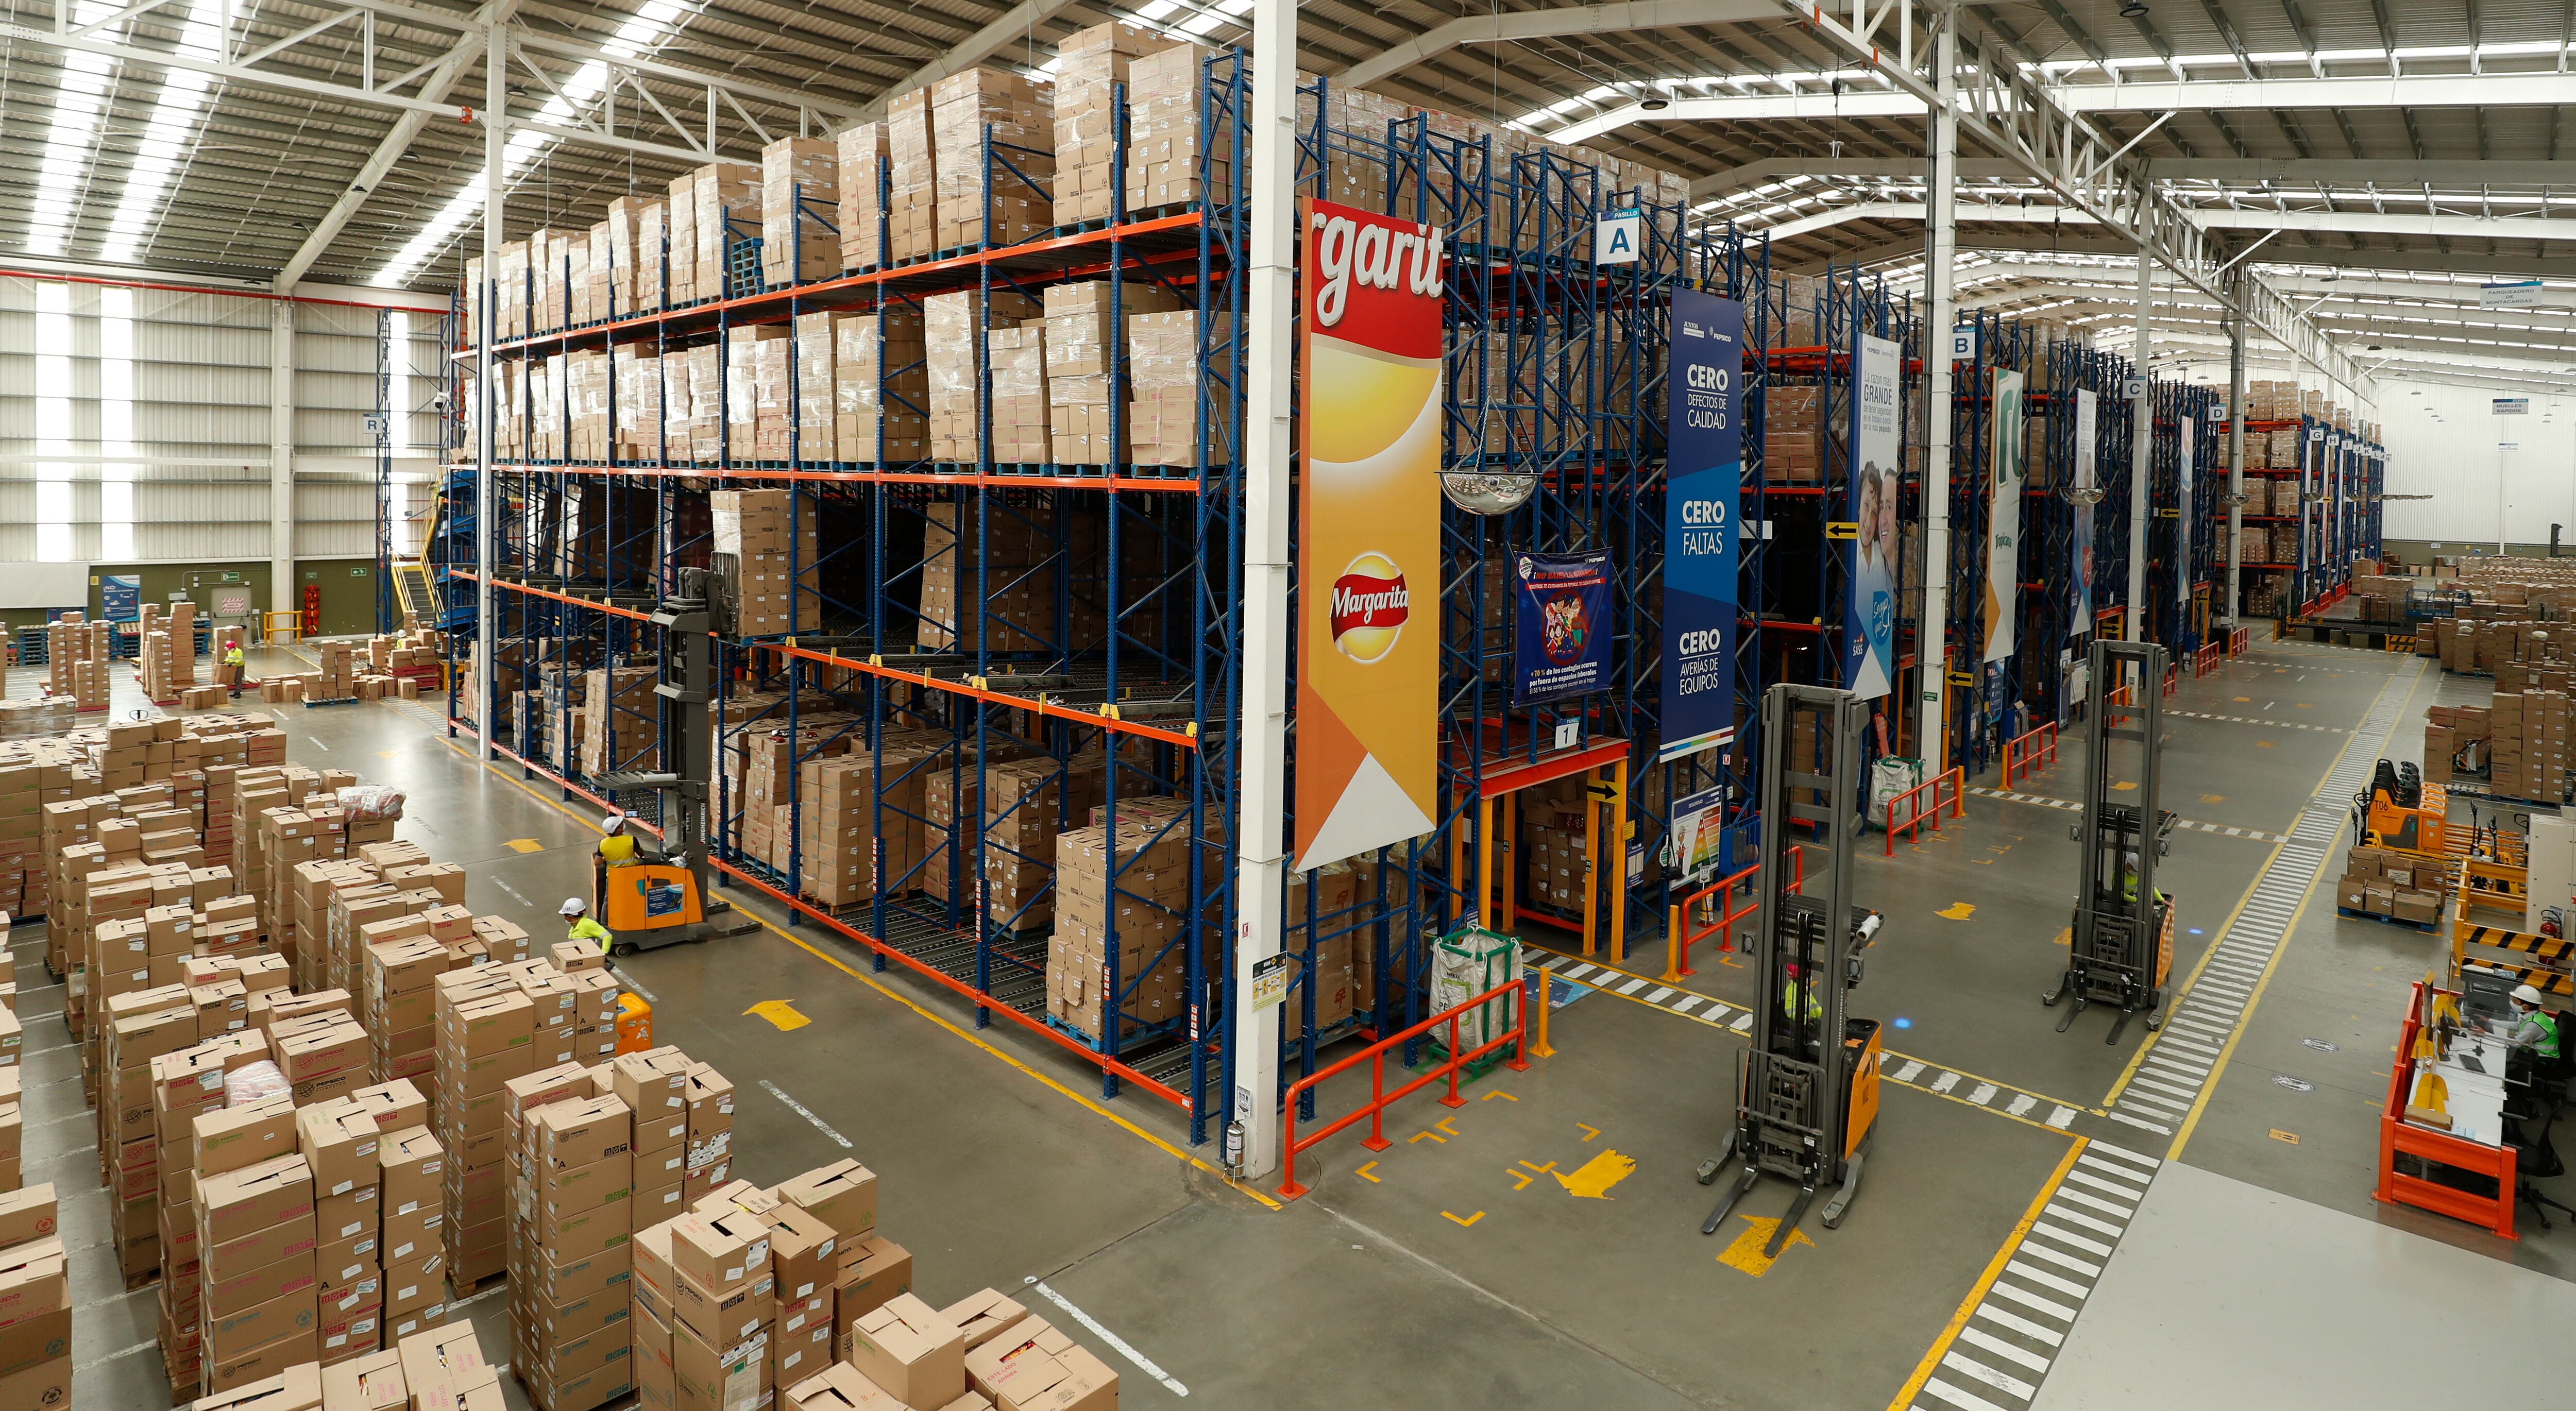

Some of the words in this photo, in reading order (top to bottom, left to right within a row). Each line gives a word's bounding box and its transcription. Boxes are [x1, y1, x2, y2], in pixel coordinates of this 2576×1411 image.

[1609, 228, 1631, 254] A
[1684, 321, 1699, 329] JUNTOS
[1714, 333, 1732, 342] PEPSICO
[1955, 338, 1969, 353] B
[1687, 364, 1728, 391] CERO
[1865, 370, 1870, 382] La
[1871, 372, 1882, 385] razón
[1883, 375, 1892, 386] más
[1864, 384, 1892, 405] GRANDE
[2129, 383, 2141, 395] C
[1688, 394, 1718, 409] DEFECTOS
[1719, 398, 1726, 410] DE
[1687, 410, 1726, 430] CALIDAD
[2214, 409, 2223, 418] D
[368, 420, 377, 430] R
[1683, 501, 1725, 523] CERO
[1684, 532, 1722, 555] FALTAS
[1995, 533, 2012, 549] Tropicana
[1329, 585, 1409, 624] Margarita
[1680, 628, 1720, 655] CERO
[1853, 644, 1863, 656] SASS
[1561, 664, 1581, 672] contagios
[1680, 657, 1708, 677] AVERÍAS
[1710, 657, 1718, 671] DE
[1558, 673, 1577, 683] espacios
[1577, 669, 1597, 677] laborales
[1680, 672, 1718, 695] EQUIPOS
[1563, 727, 1569, 744] 1
[1688, 799, 1703, 808] SEGURIDAD
[2375, 800, 2388, 811] T06
[316, 1048, 345, 1059] PEPSICO
[409, 1054, 432, 1063] PEPSICO
[316, 1076, 346, 1087] PEPSICO
[542, 1088, 569, 1099] PEPSICO
[320, 1281, 329, 1290] A
[685, 1284, 703, 1302] PEPSICO
[237, 1358, 261, 1368] PEPSICO
[987, 1370, 1001, 1381] ESTE
[1002, 1363, 1016, 1373] LADO
[997, 1370, 1018, 1384] ARRIBA
